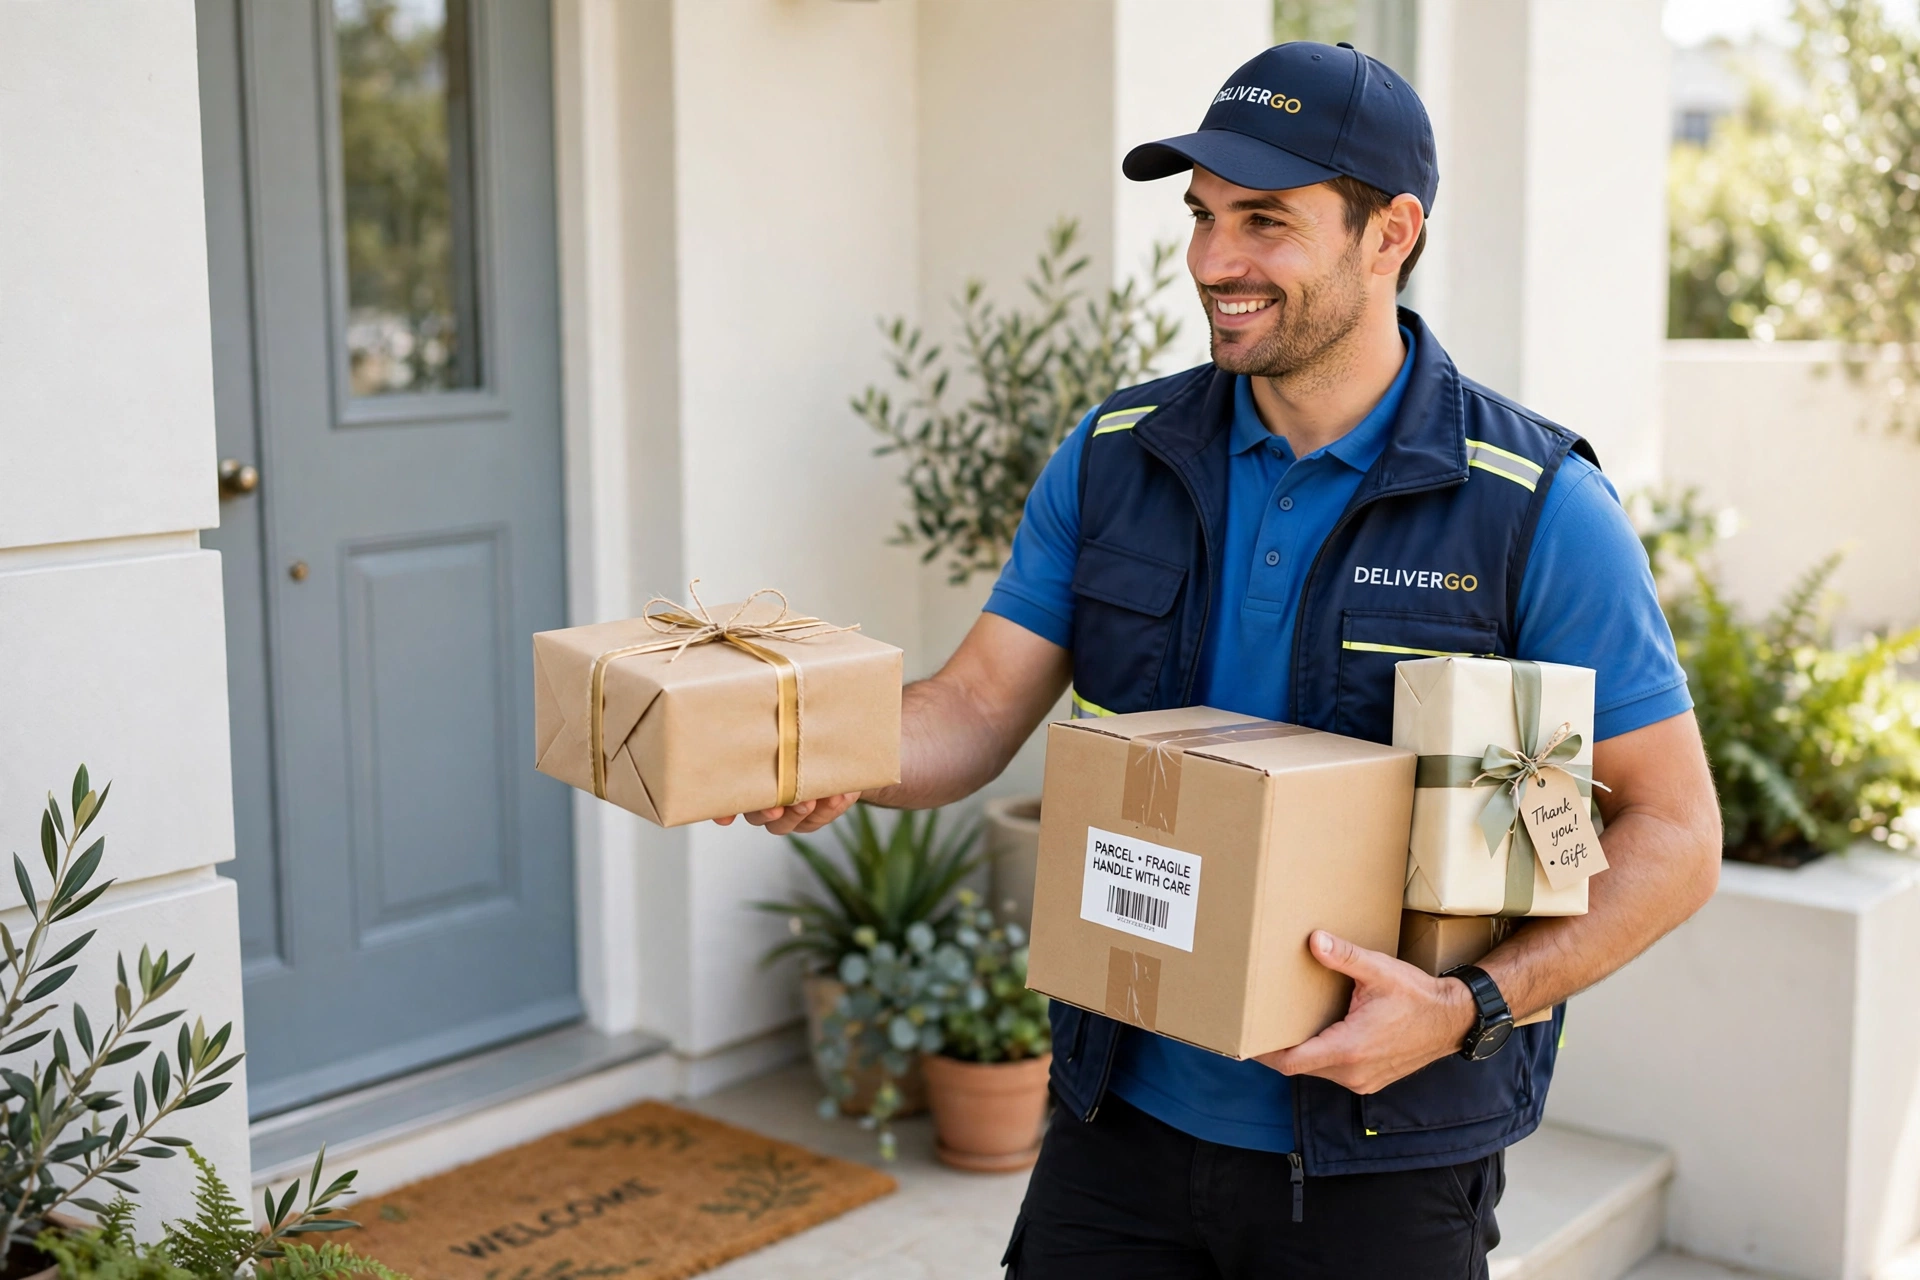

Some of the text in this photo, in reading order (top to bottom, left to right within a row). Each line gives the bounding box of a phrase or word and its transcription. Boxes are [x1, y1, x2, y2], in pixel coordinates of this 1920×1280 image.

[1354, 566, 1478, 592] DELIVERGO
[1531, 797, 1573, 826] Thank
[1551, 813, 1579, 847] you!
[1095, 840, 1191, 879] PARCEL FRAGILE
[1560, 843, 1588, 868] Gift
[1093, 856, 1191, 896] HANDLE WITH CARE
[449, 1177, 661, 1259] WELCOME
